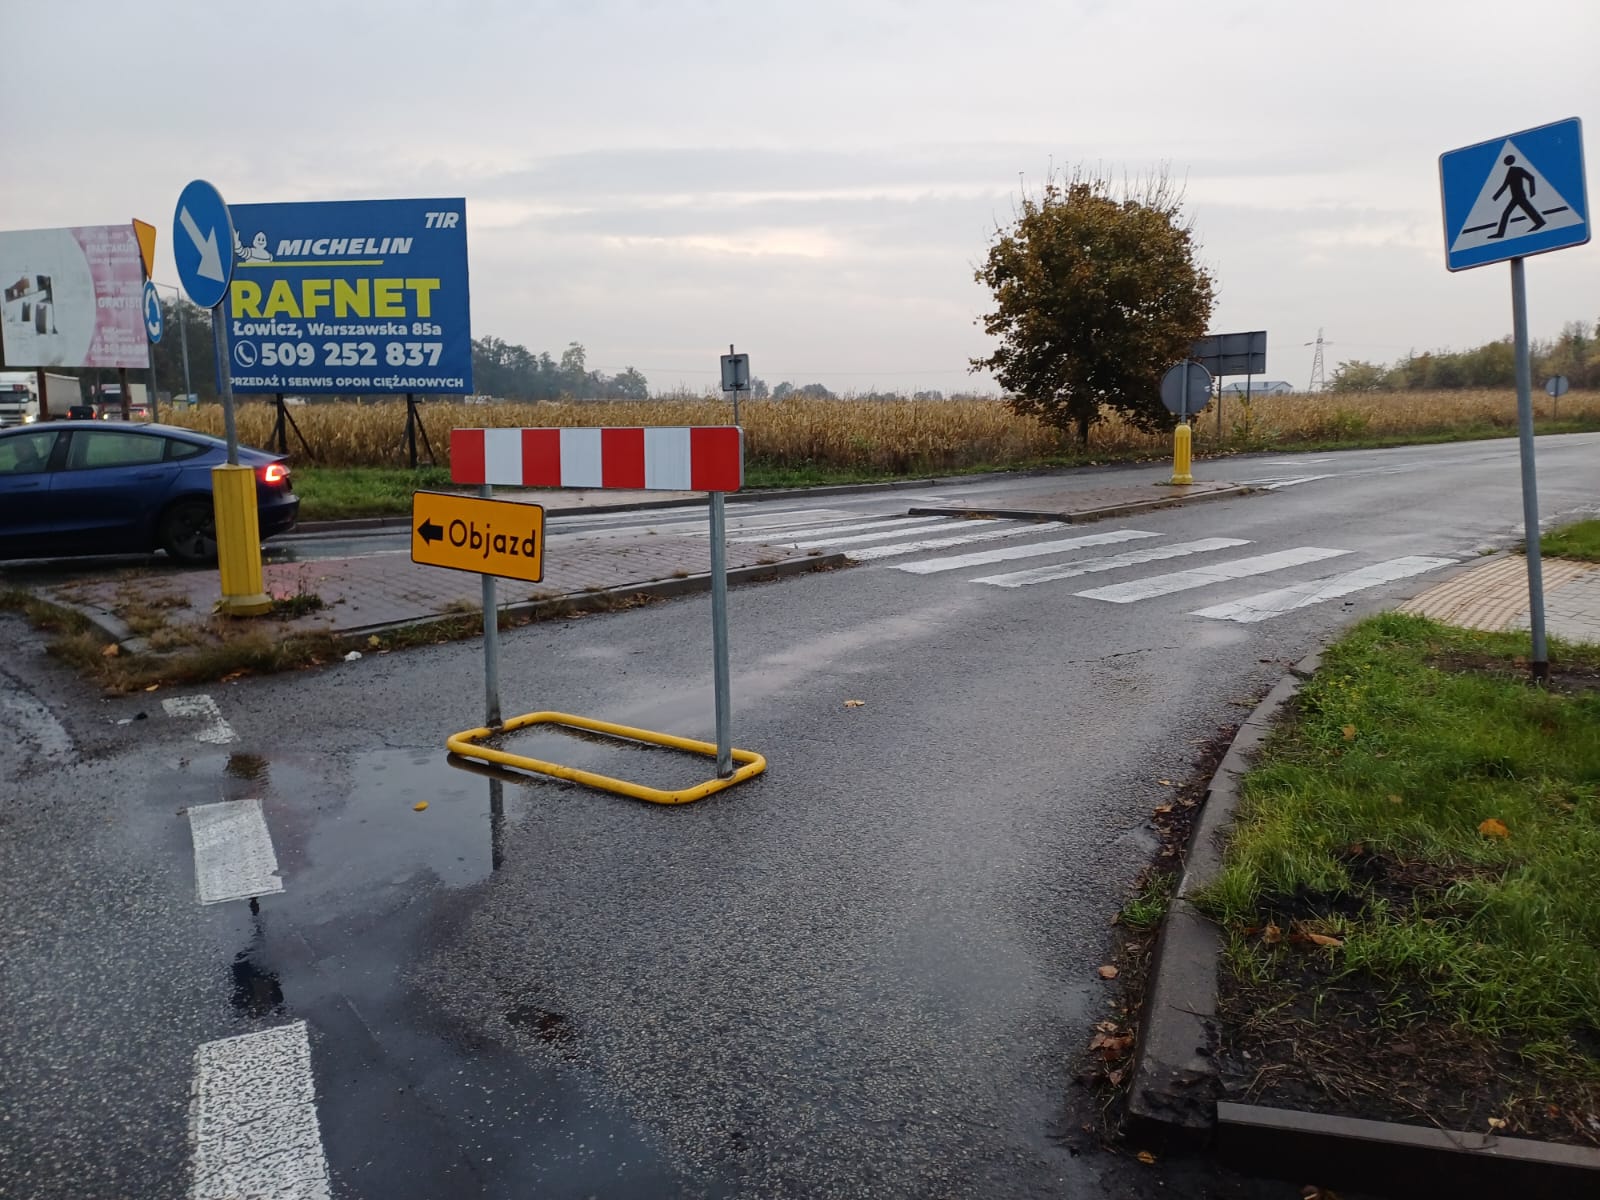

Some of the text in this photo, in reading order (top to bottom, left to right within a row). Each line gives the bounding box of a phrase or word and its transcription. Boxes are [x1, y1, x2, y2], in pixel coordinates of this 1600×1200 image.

[425, 212, 459, 228] TIR
[276, 237, 413, 256] MICHELIN
[230, 278, 440, 319] RAFNET
[233, 318, 442, 339] Łowicz, Warszawska 85a
[261, 342, 443, 366] 509 252 837
[230, 374, 464, 389] PRZEDAŻ I SERWIS OPON CIĘŻAROWYCH
[449, 519, 536, 559] Objazd
